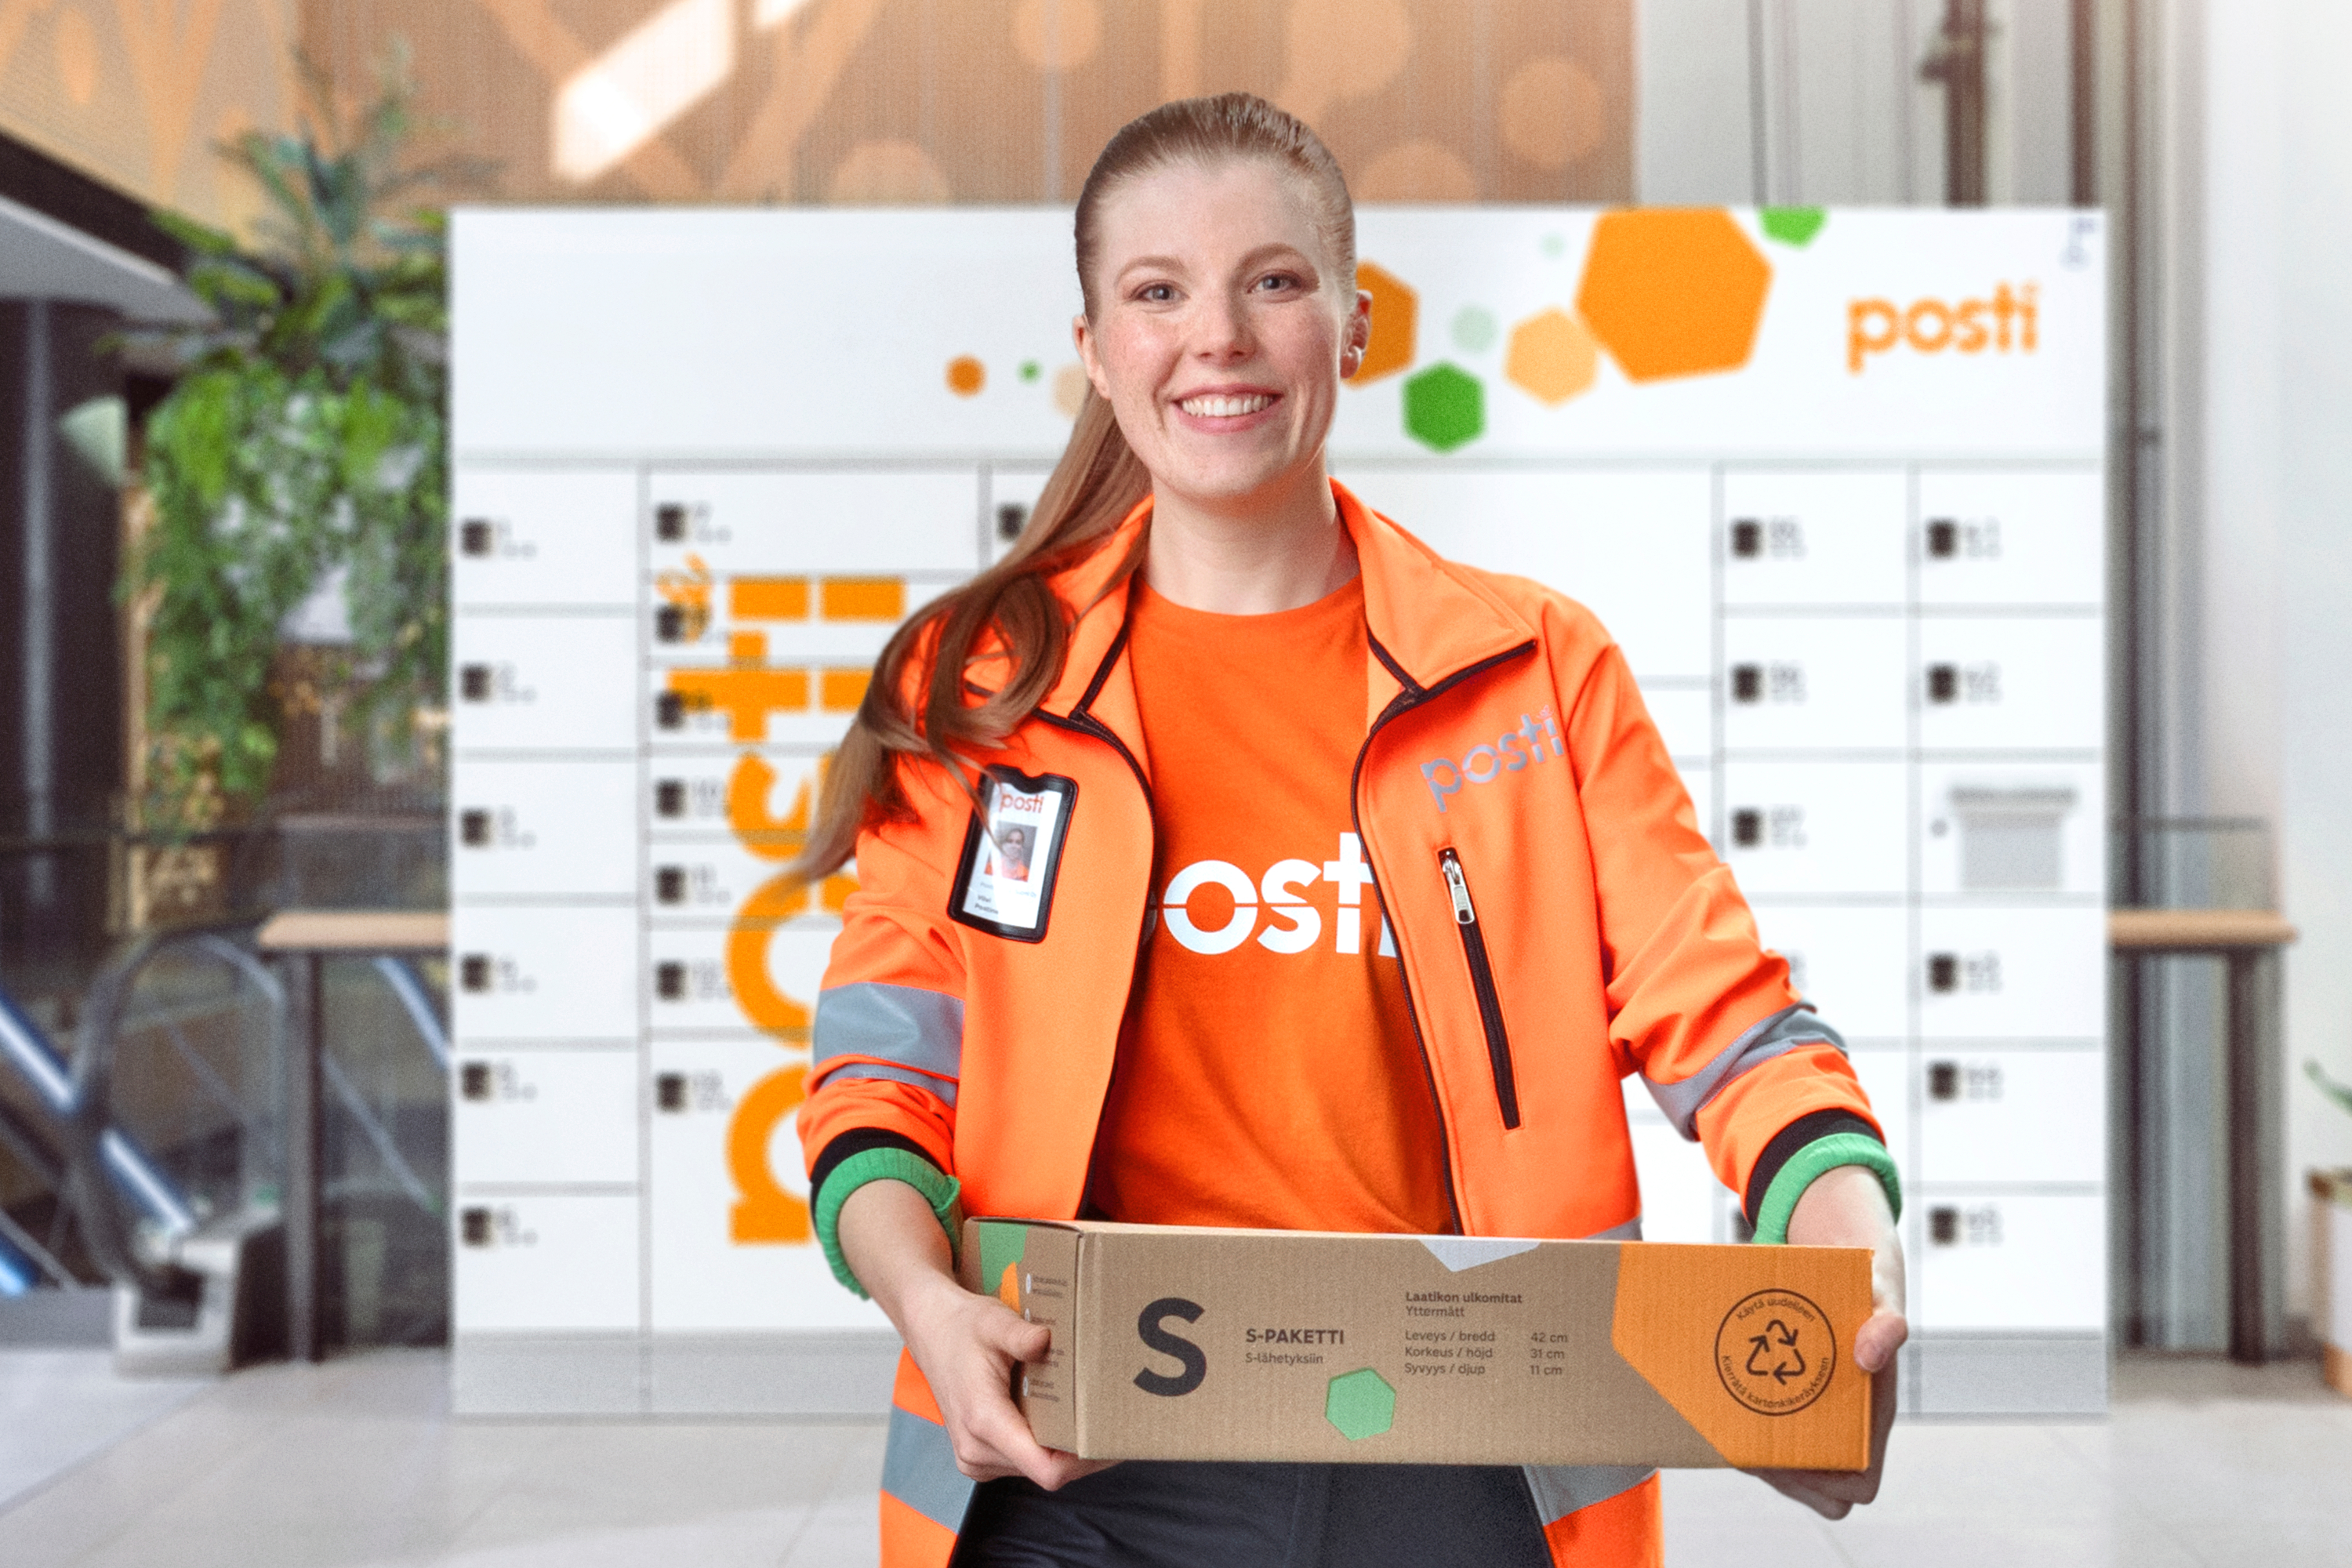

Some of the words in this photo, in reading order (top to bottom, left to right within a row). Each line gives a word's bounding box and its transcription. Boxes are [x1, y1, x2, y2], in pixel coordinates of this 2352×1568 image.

[1846, 280, 2040, 376] posti
[1420, 706, 1563, 812] posti
[999, 794, 1044, 814] posti
[1145, 832, 1398, 957] ost
[1405, 1291, 1460, 1303] Laatikon
[1463, 1292, 1523, 1305] ulkomitat
[1405, 1305, 1466, 1318] Yttermått
[1736, 1298, 1766, 1321] Käytä
[1245, 1328, 1345, 1345] S-PAKETTI
[1404, 1330, 1447, 1343] Leveys
[1458, 1330, 1496, 1342] bredd
[1530, 1332, 1546, 1343] 42
[1549, 1334, 1569, 1343] cm
[1133, 1298, 1207, 1397] S
[1404, 1346, 1454, 1358] Korkeus
[1465, 1347, 1494, 1360] höjd
[1530, 1348, 1543, 1359] 31
[1546, 1350, 1566, 1359] cm
[1245, 1352, 1324, 1366] S-lähetyksiin
[1404, 1362, 1446, 1377] Syvyys
[1457, 1363, 1486, 1377] djup
[1529, 1364, 1540, 1376] 11
[1543, 1367, 1563, 1377] cm
